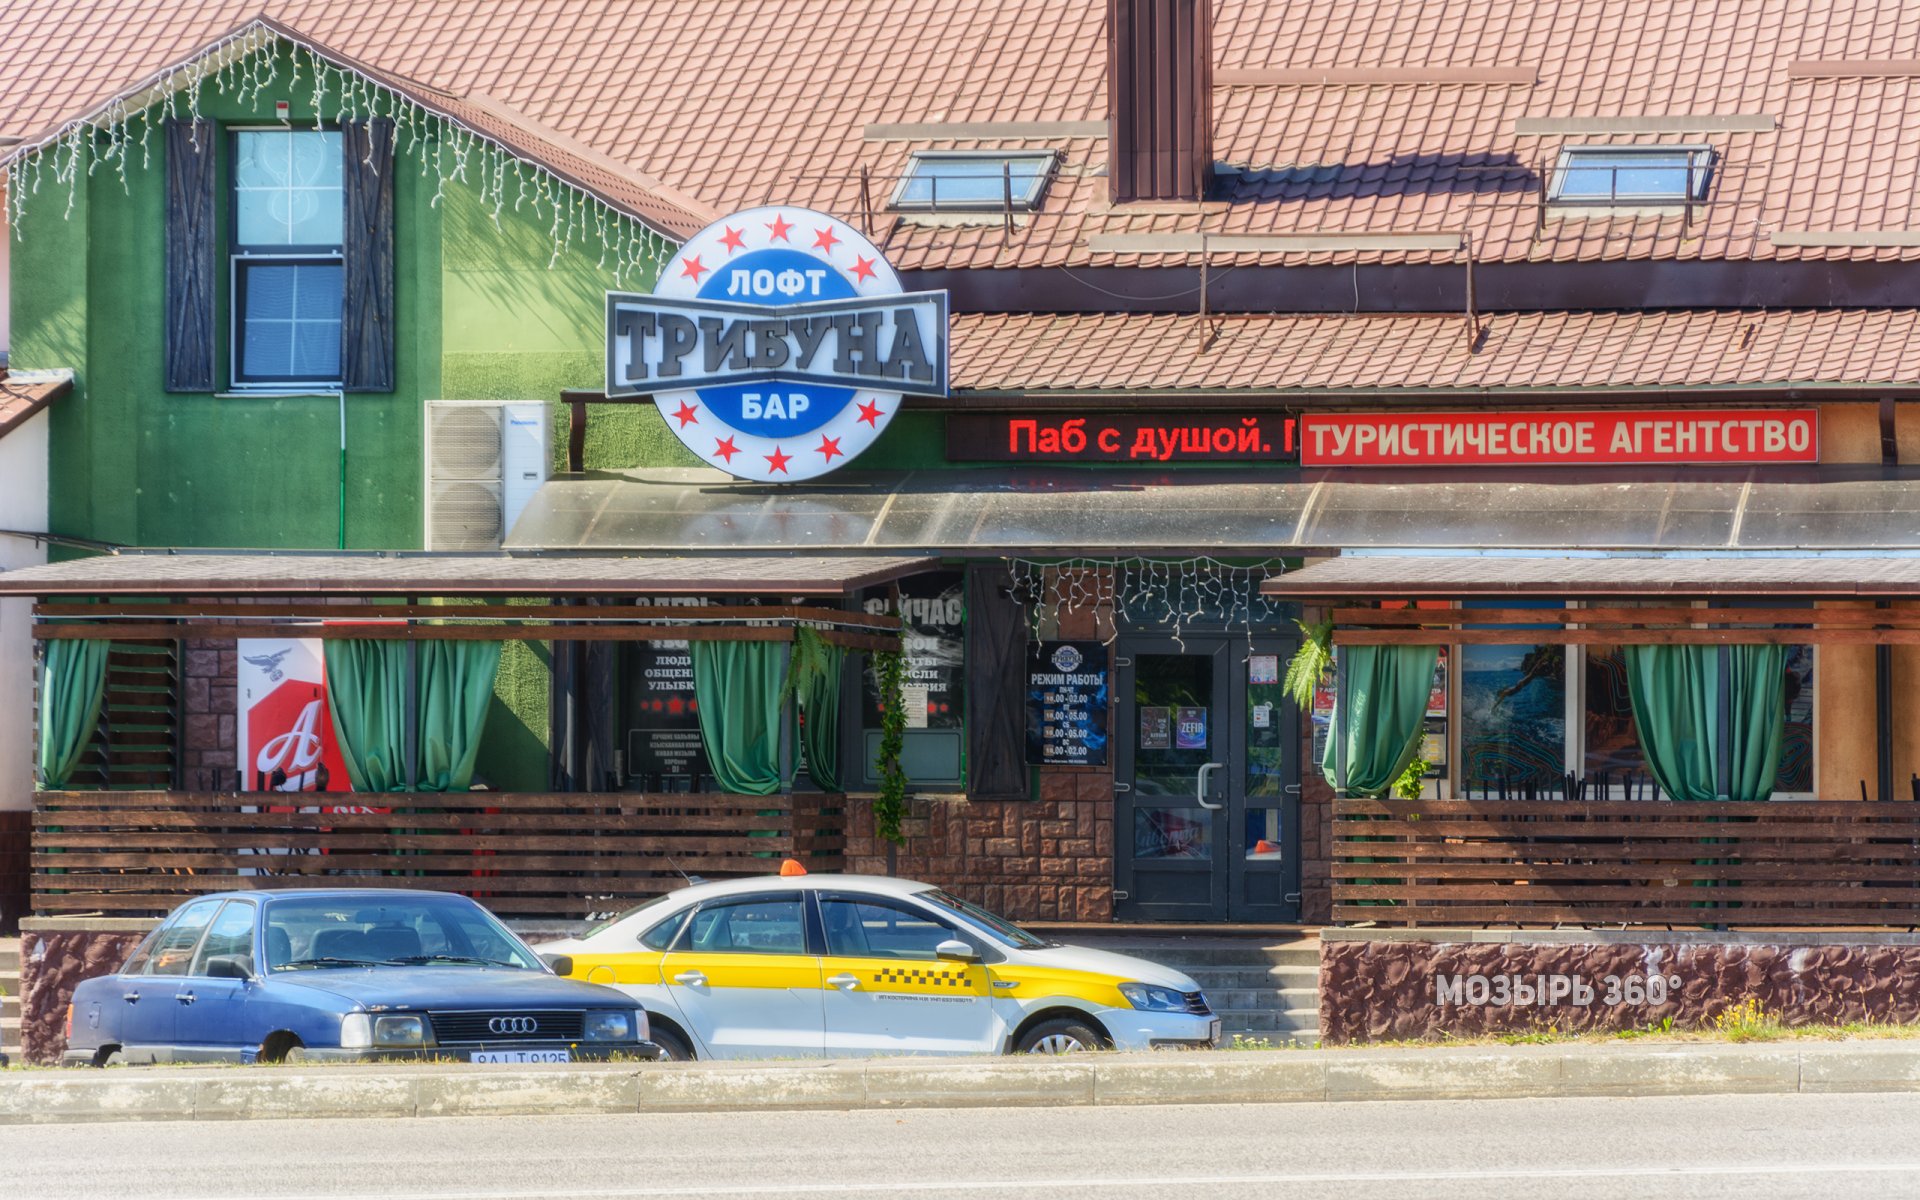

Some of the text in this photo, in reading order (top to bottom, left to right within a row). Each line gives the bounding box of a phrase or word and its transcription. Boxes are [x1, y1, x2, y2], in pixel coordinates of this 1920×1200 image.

[727, 269, 826, 296] ЛОФТ
[616, 308, 934, 382] ТРИБУНА
[741, 393, 810, 420] БАР
[1009, 418, 1087, 453] Паб
[1097, 427, 1121, 453] с
[1130, 417, 1272, 461] душой.
[1308, 421, 1596, 457] ТУРИСТИЧЕСКОЕ
[1608, 419, 1811, 455] АГЕНТСТВО
[1031, 673, 1103, 686] РЕЖИМ РАБОТЫ
[1182, 722, 1204, 733] ZEFIR
